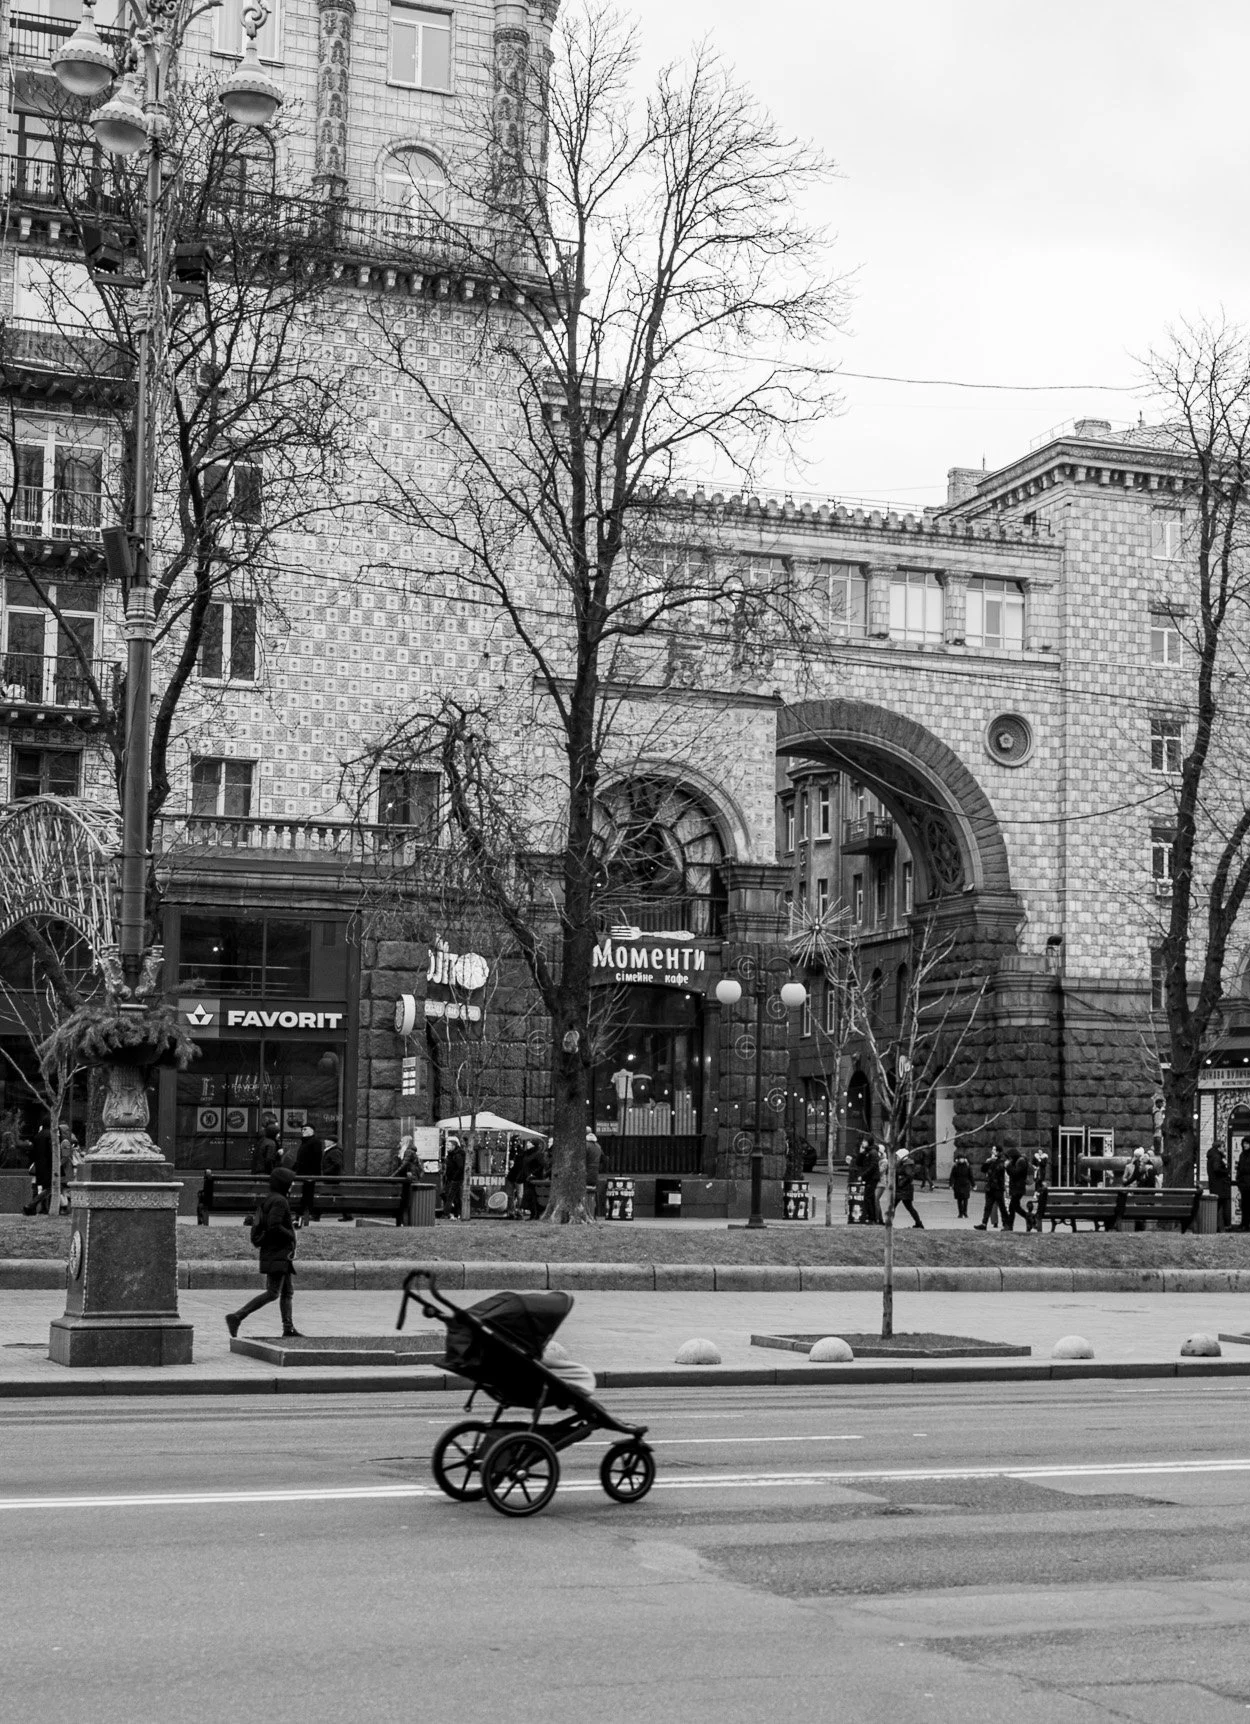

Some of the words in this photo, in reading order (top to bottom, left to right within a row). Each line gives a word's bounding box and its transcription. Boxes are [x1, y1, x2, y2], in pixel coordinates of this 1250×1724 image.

[592, 939, 705, 970] Моменти
[615, 971, 653, 983] сімейне
[664, 973, 689, 986] кафе
[227, 1010, 343, 1029] FAVORIT
